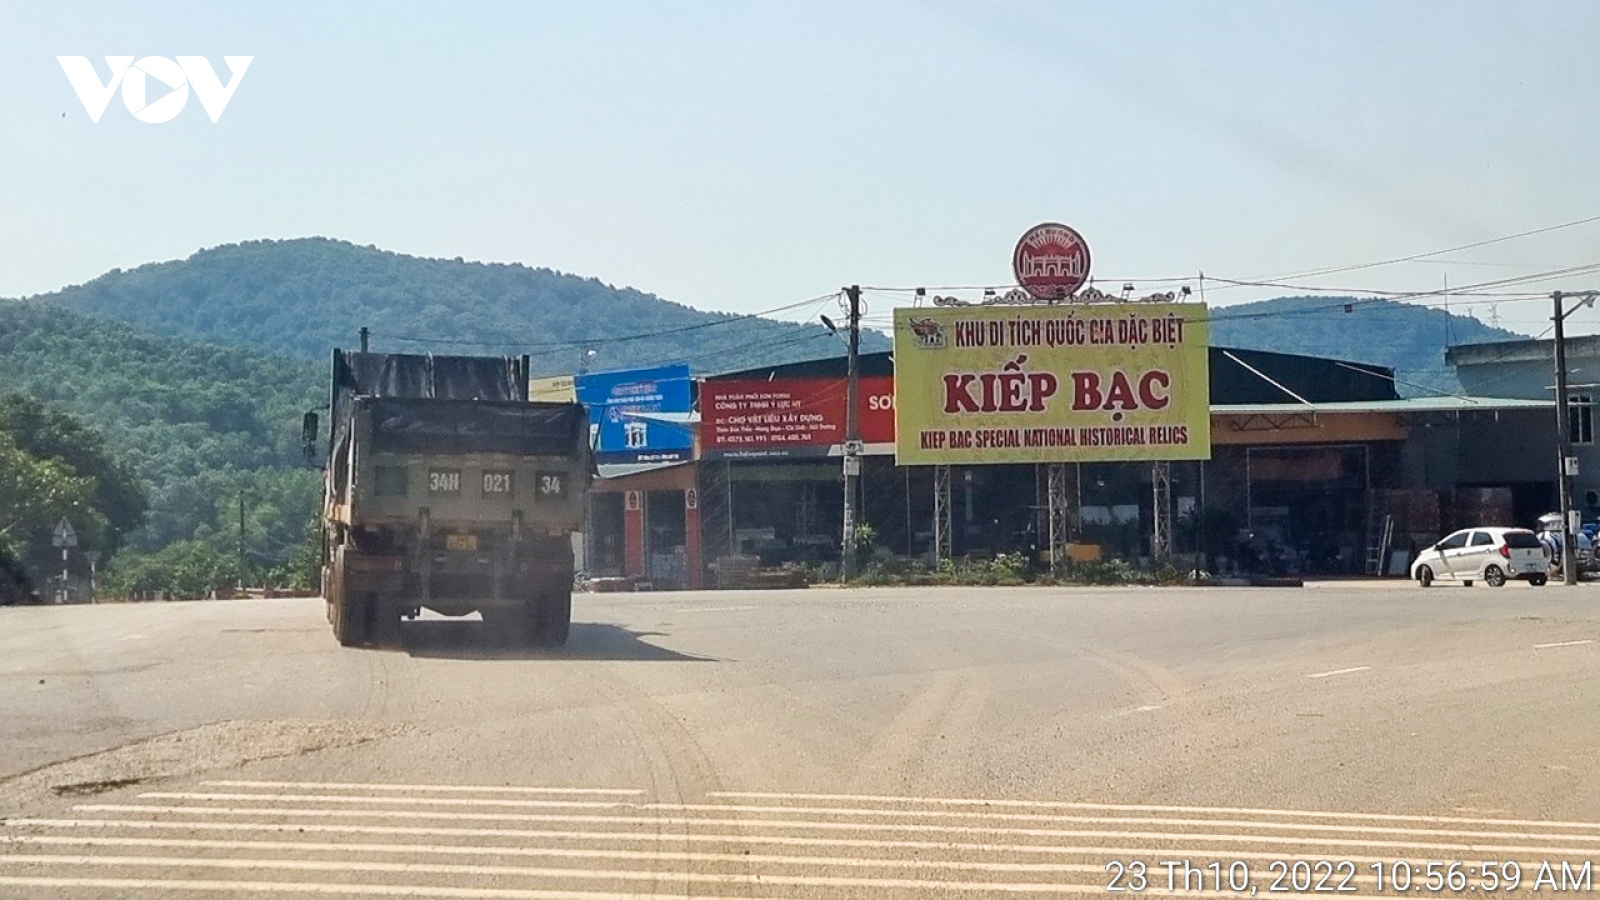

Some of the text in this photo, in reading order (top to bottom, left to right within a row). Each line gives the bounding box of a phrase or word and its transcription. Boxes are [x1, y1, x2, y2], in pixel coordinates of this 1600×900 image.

[955, 310, 1185, 350] KHU DI TÍCH QUỐC GIA ĐẶC BIỆT
[943, 354, 1170, 422] KIẾP BẠC
[739, 401, 748, 409] TY
[869, 392, 896, 411] SƠ
[920, 425, 1188, 449] KIEP BAC SPECIAL NATIONAL HISTORICAL RELICS
[429, 472, 561, 494] 34H 021 34
